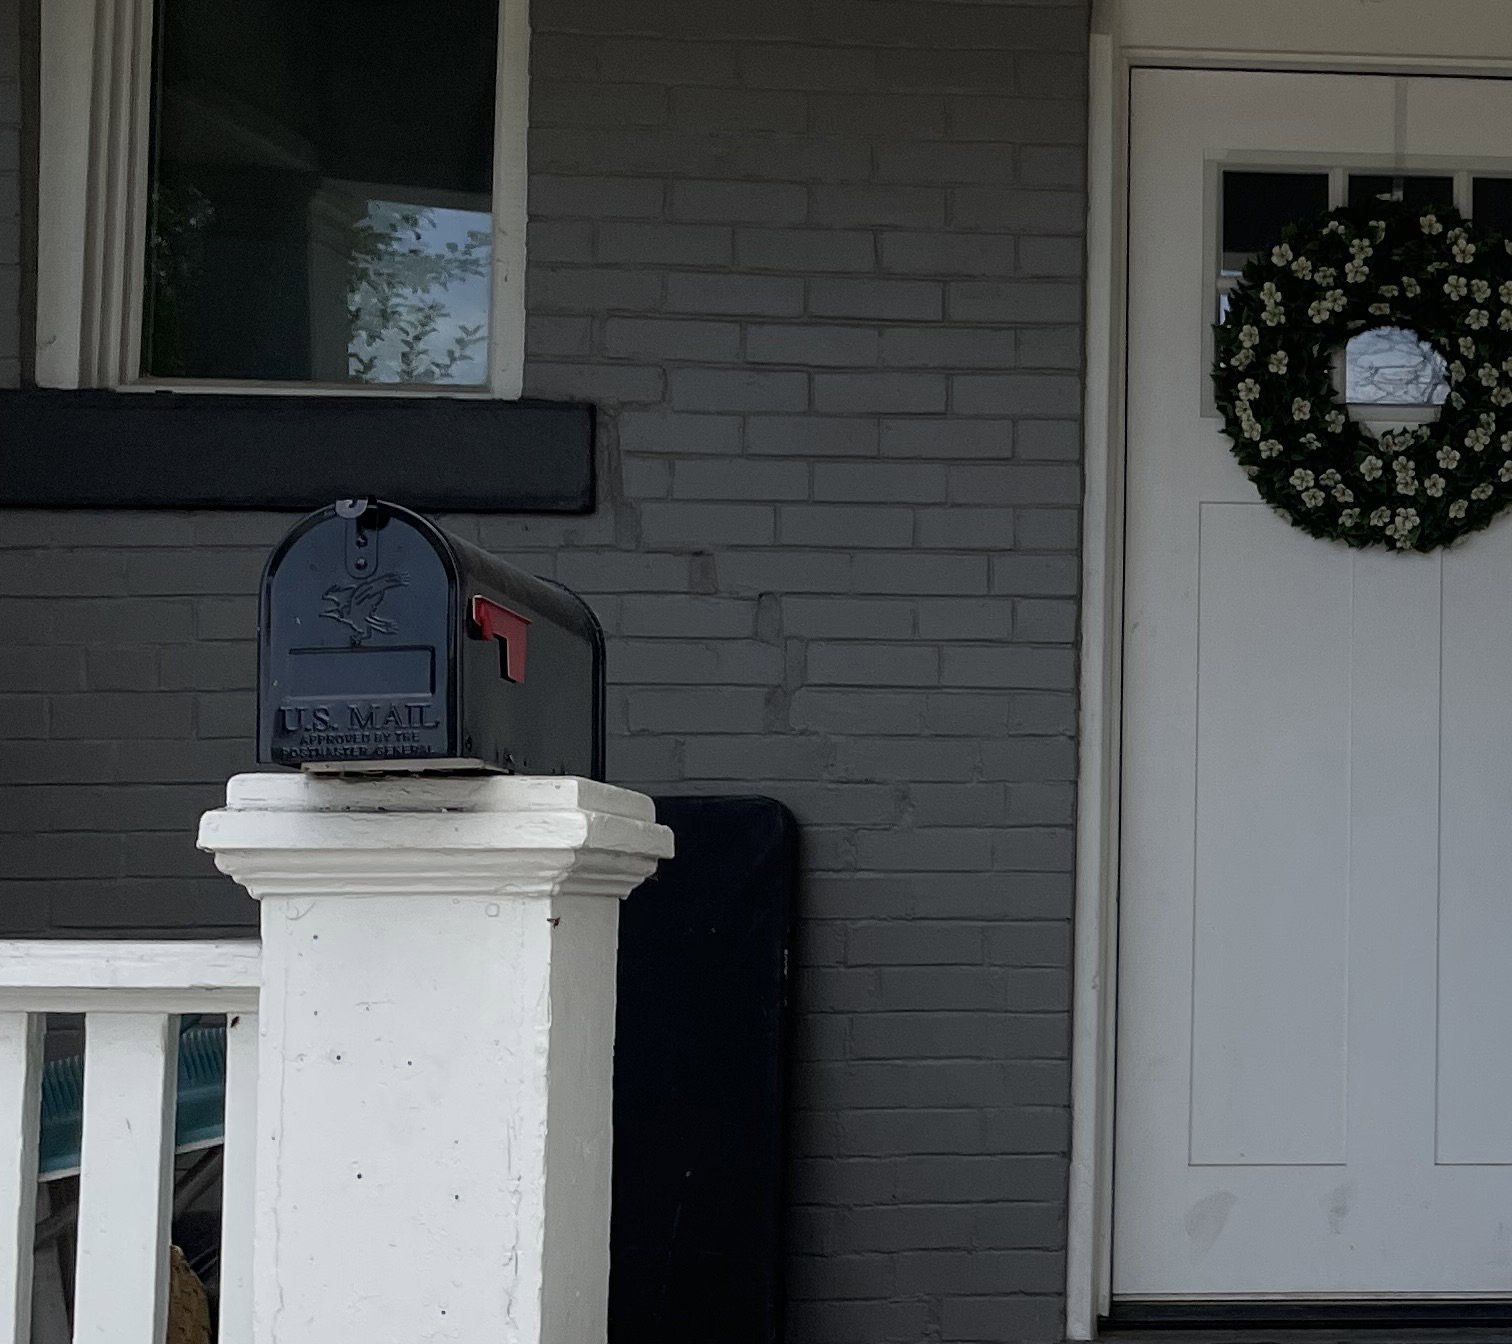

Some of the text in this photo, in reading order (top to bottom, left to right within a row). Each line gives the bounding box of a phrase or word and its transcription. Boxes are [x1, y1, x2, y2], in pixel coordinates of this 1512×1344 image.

[281, 703, 438, 732] U.S. MAIL
[300, 731, 420, 746] APPROVED BY THE
